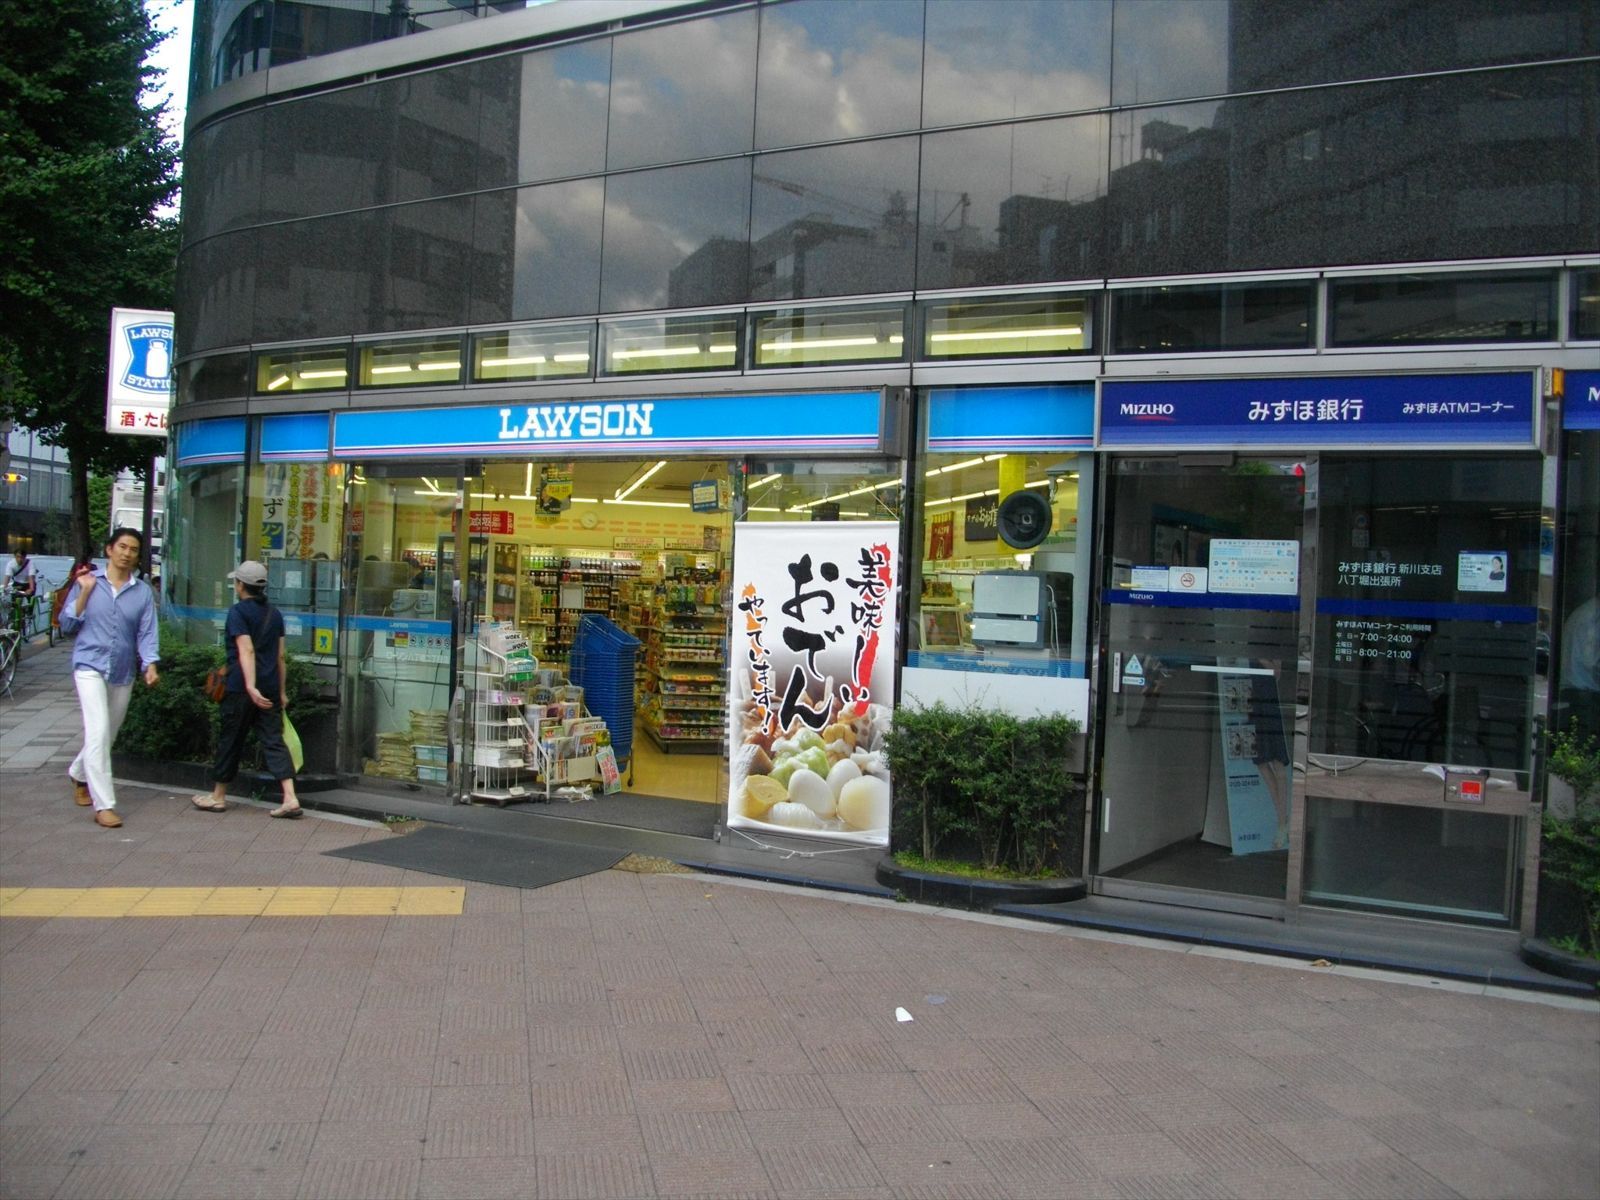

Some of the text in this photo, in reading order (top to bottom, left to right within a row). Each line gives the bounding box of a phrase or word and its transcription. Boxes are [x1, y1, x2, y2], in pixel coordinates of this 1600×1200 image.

[1120, 403, 1175, 415] MIZUHO
[1248, 398, 1364, 421] みずほ銀行
[1402, 402, 1514, 414] みずほATMコーナー
[498, 403, 654, 439] LAWSON
[1337, 562, 1442, 576] みずほ銀行 新川支店
[1338, 574, 1401, 587] 八丁堀出張所
[1129, 592, 1154, 600] MIZUHO
[840, 547, 886, 703] 美味しい
[779, 553, 844, 732] おでん
